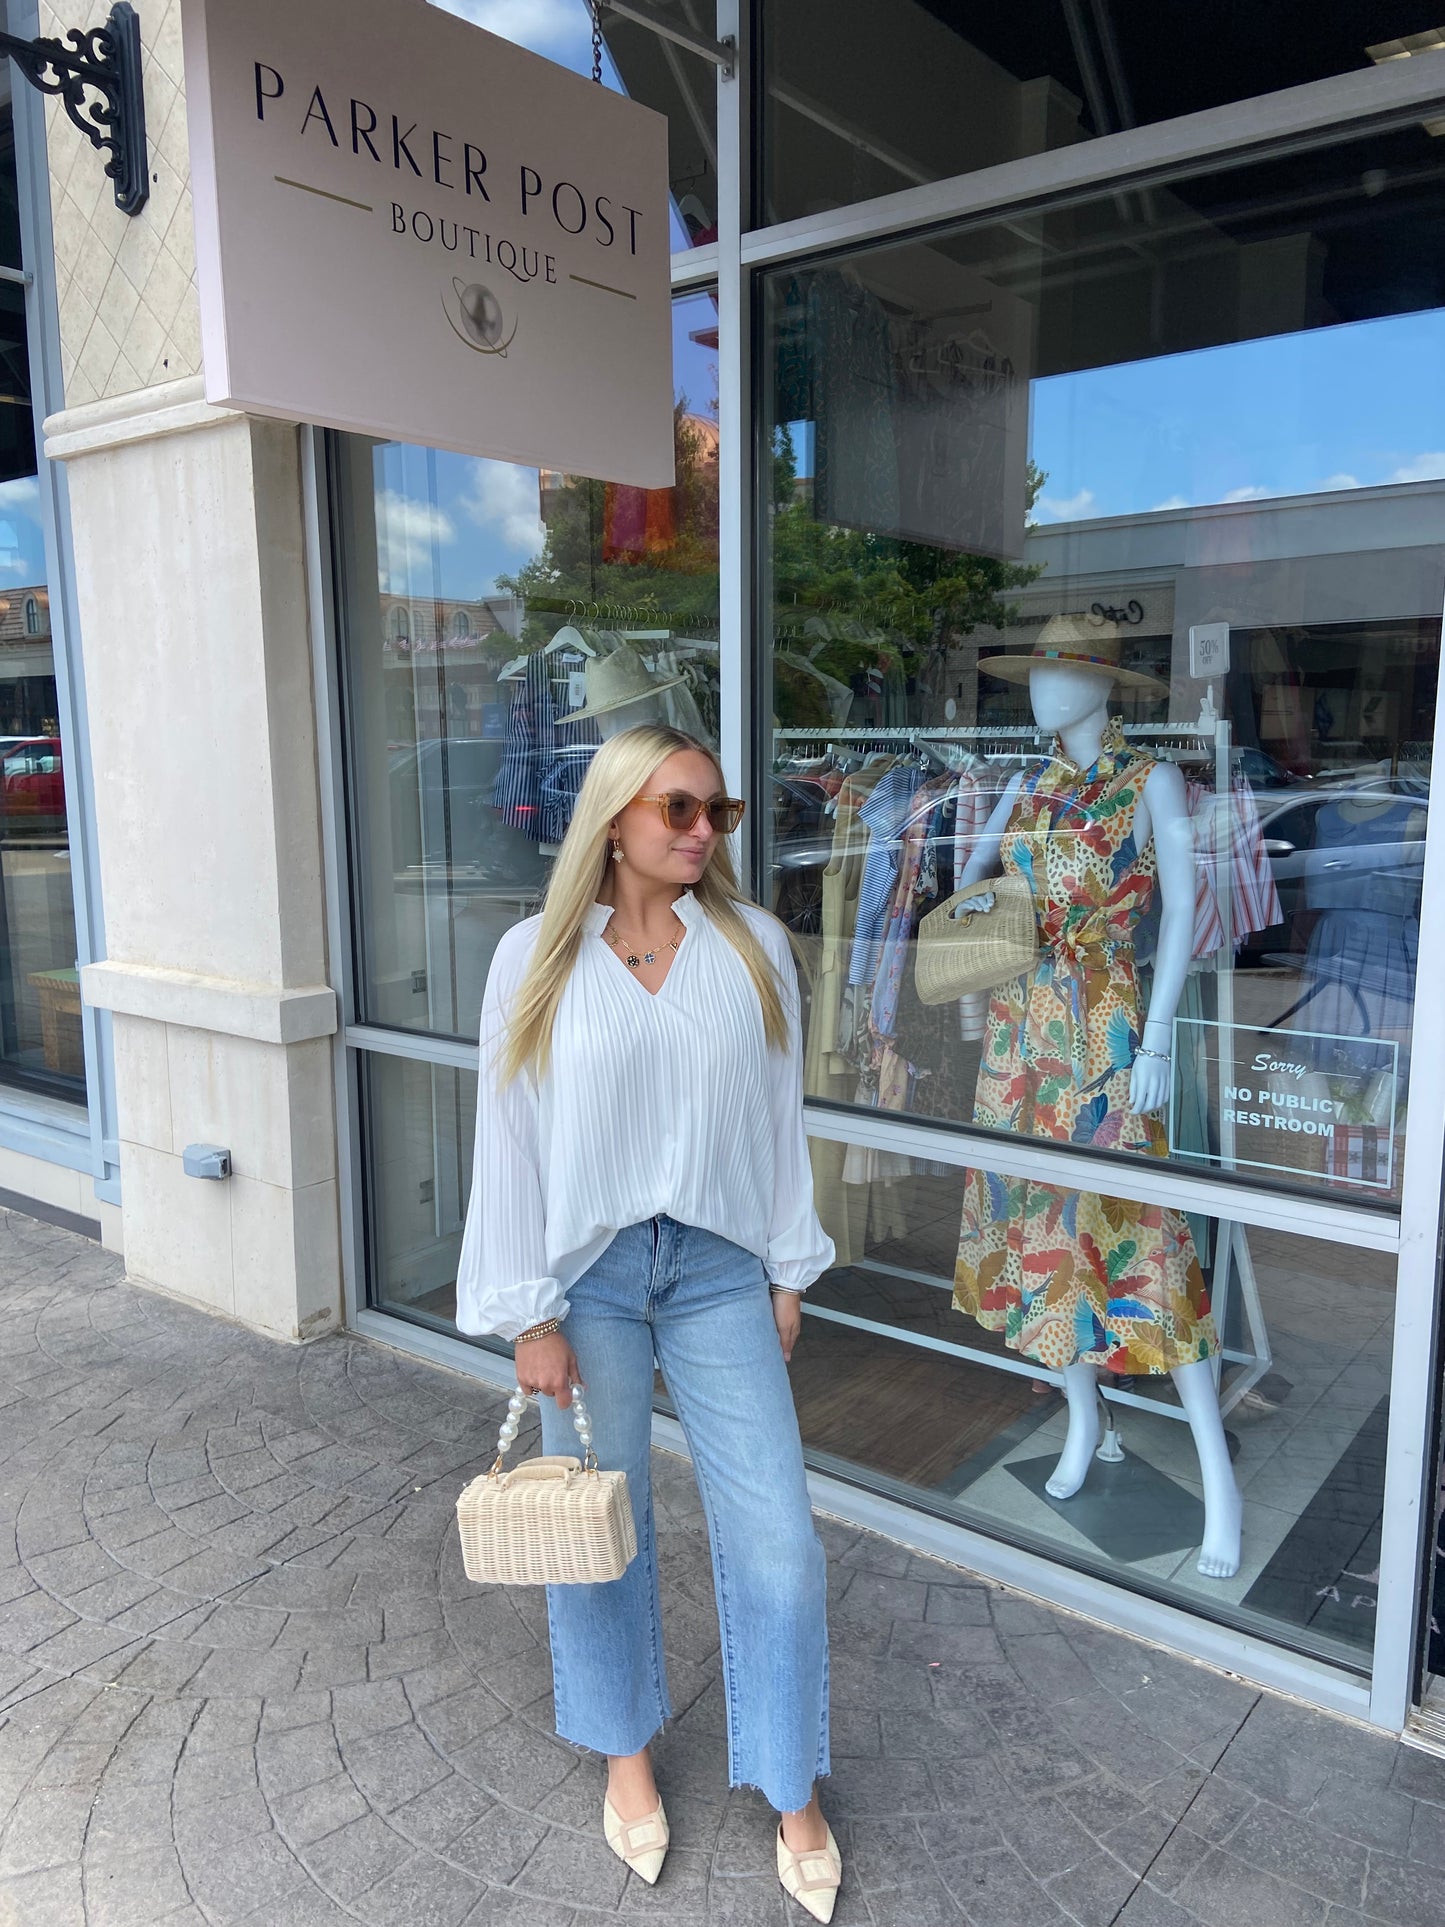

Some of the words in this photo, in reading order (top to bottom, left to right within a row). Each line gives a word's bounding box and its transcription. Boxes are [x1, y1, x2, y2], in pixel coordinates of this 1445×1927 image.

[253, 61, 491, 203] PARKER
[520, 165, 644, 256] POST
[390, 202, 558, 284] BOUTIQUE
[1199, 639, 1218, 656] 50%
[1251, 1053, 1307, 1080] Sorry
[1223, 1086, 1252, 1102] NO
[1258, 1090, 1334, 1114] PUBLIC
[1223, 1108, 1335, 1137] RESTROOM
